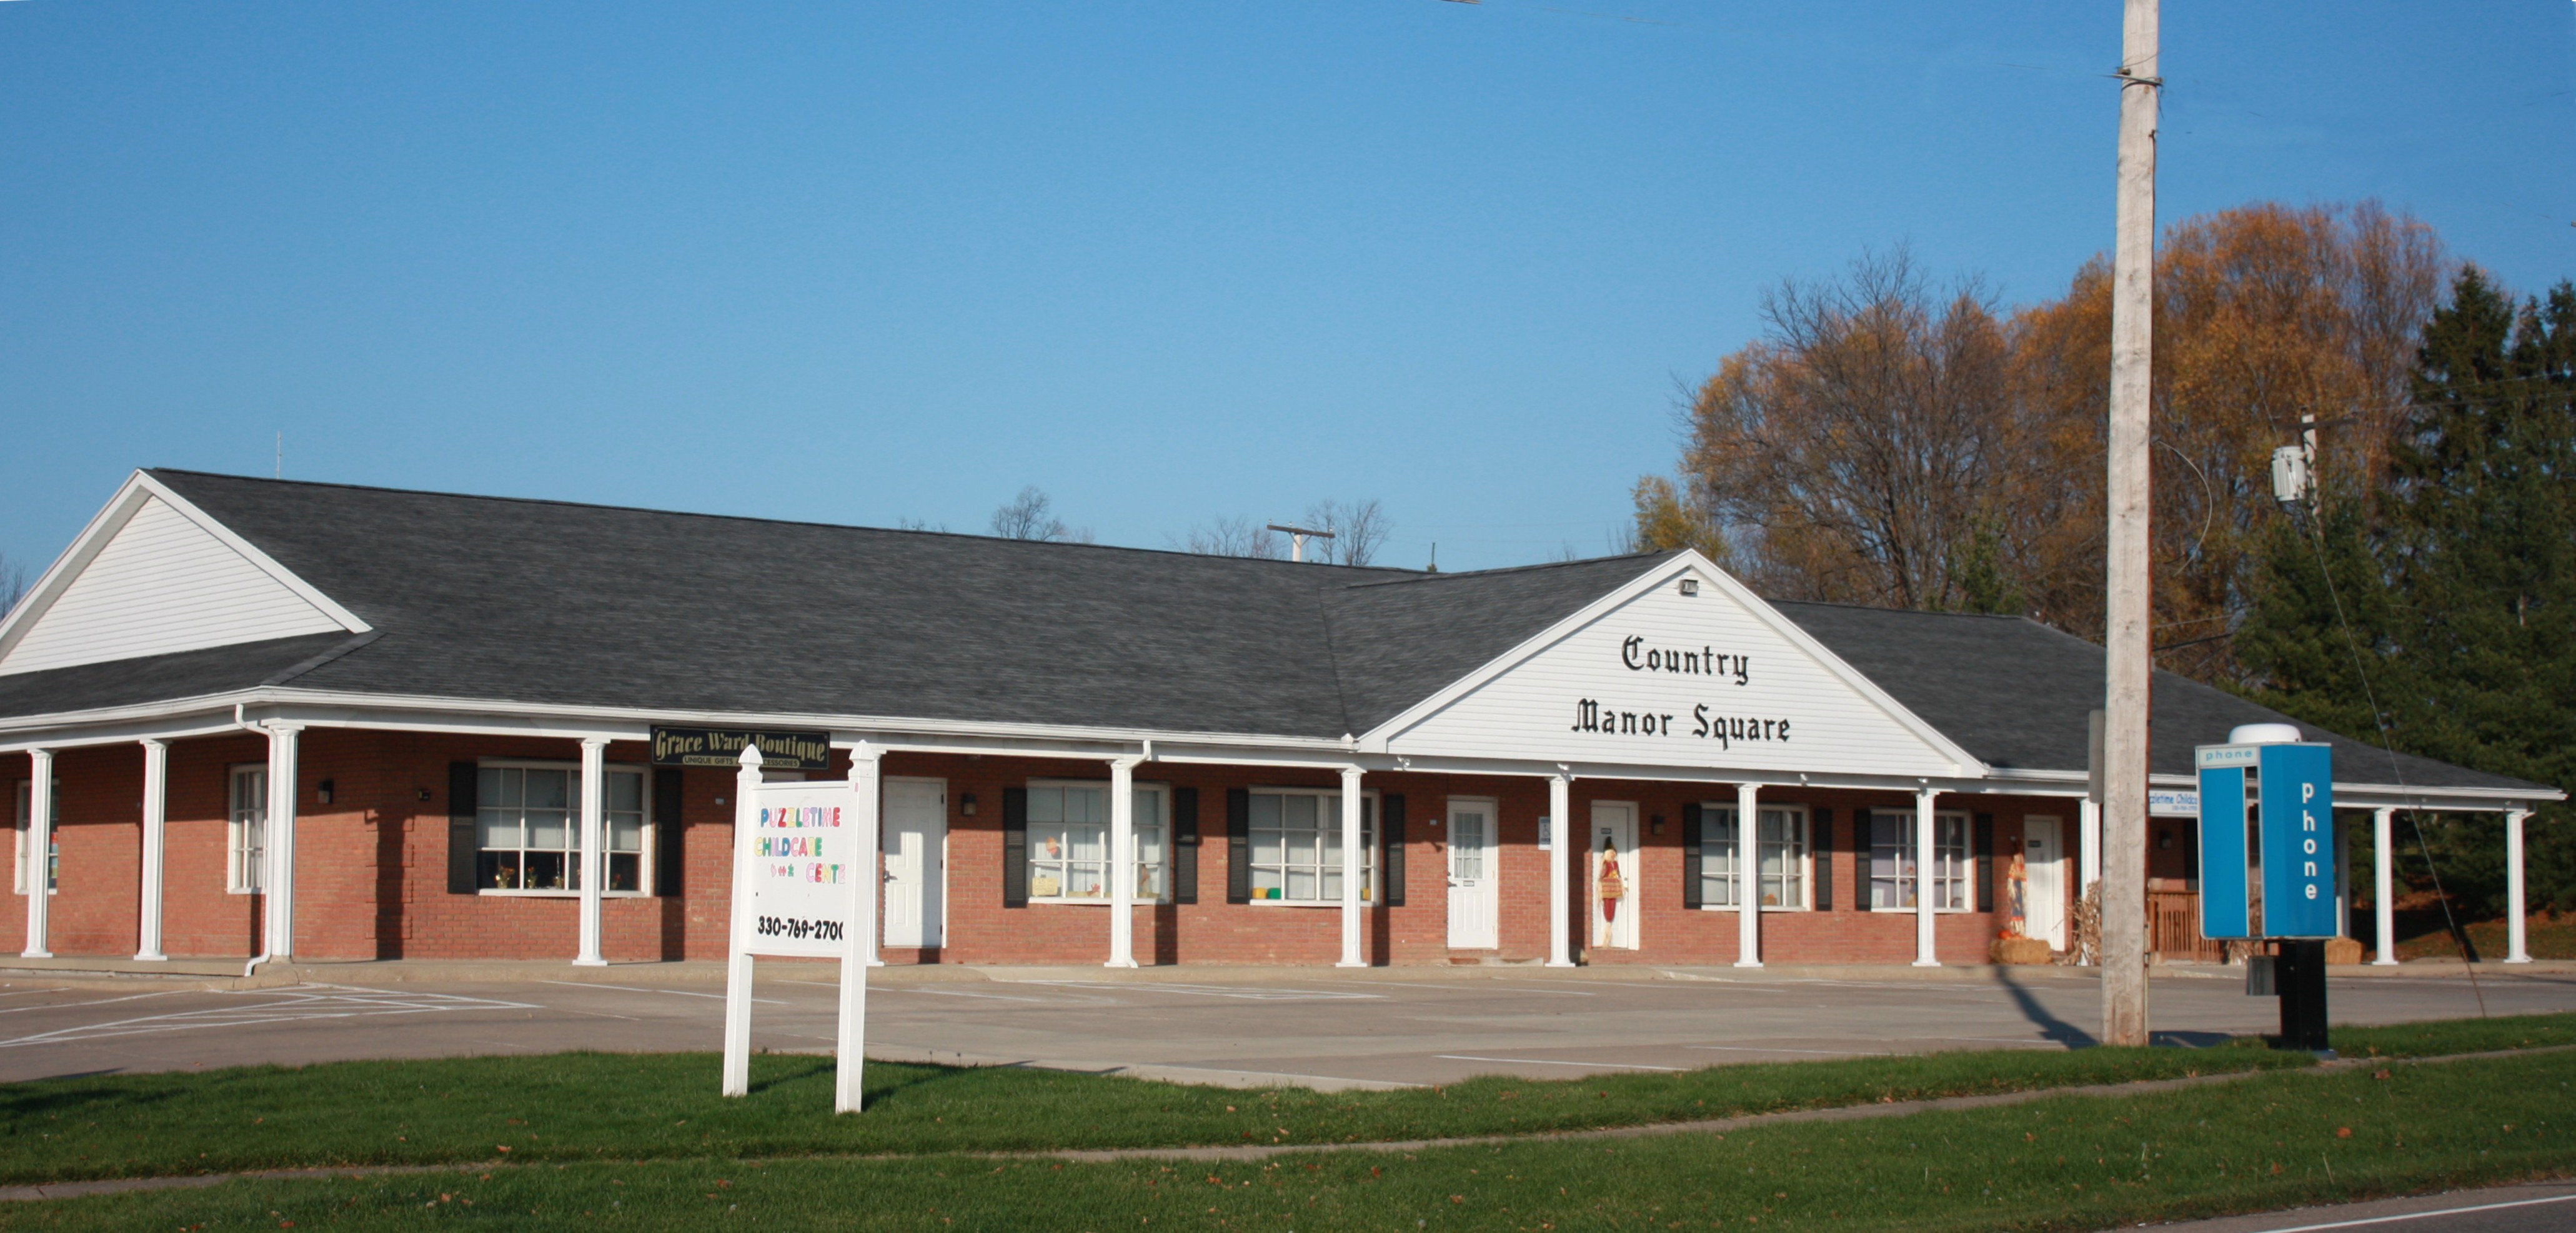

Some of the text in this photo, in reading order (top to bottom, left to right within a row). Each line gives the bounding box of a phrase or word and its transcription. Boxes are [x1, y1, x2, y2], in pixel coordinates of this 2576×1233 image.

[1621, 634, 1749, 686] Country
[1570, 697, 1790, 751] Manor Square
[655, 730, 825, 762] Grace Ward Boutique
[2206, 750, 2252, 761] phone
[684, 756, 712, 765] UNIQUE
[714, 757, 734, 765] GIFTS
[763, 759, 798, 767] CESSORIES
[760, 807, 840, 828] PUZZLETIME
[754, 836, 823, 857] CHILDCARE
[2301, 782, 2317, 900] phone
[805, 862, 846, 884] CENTE
